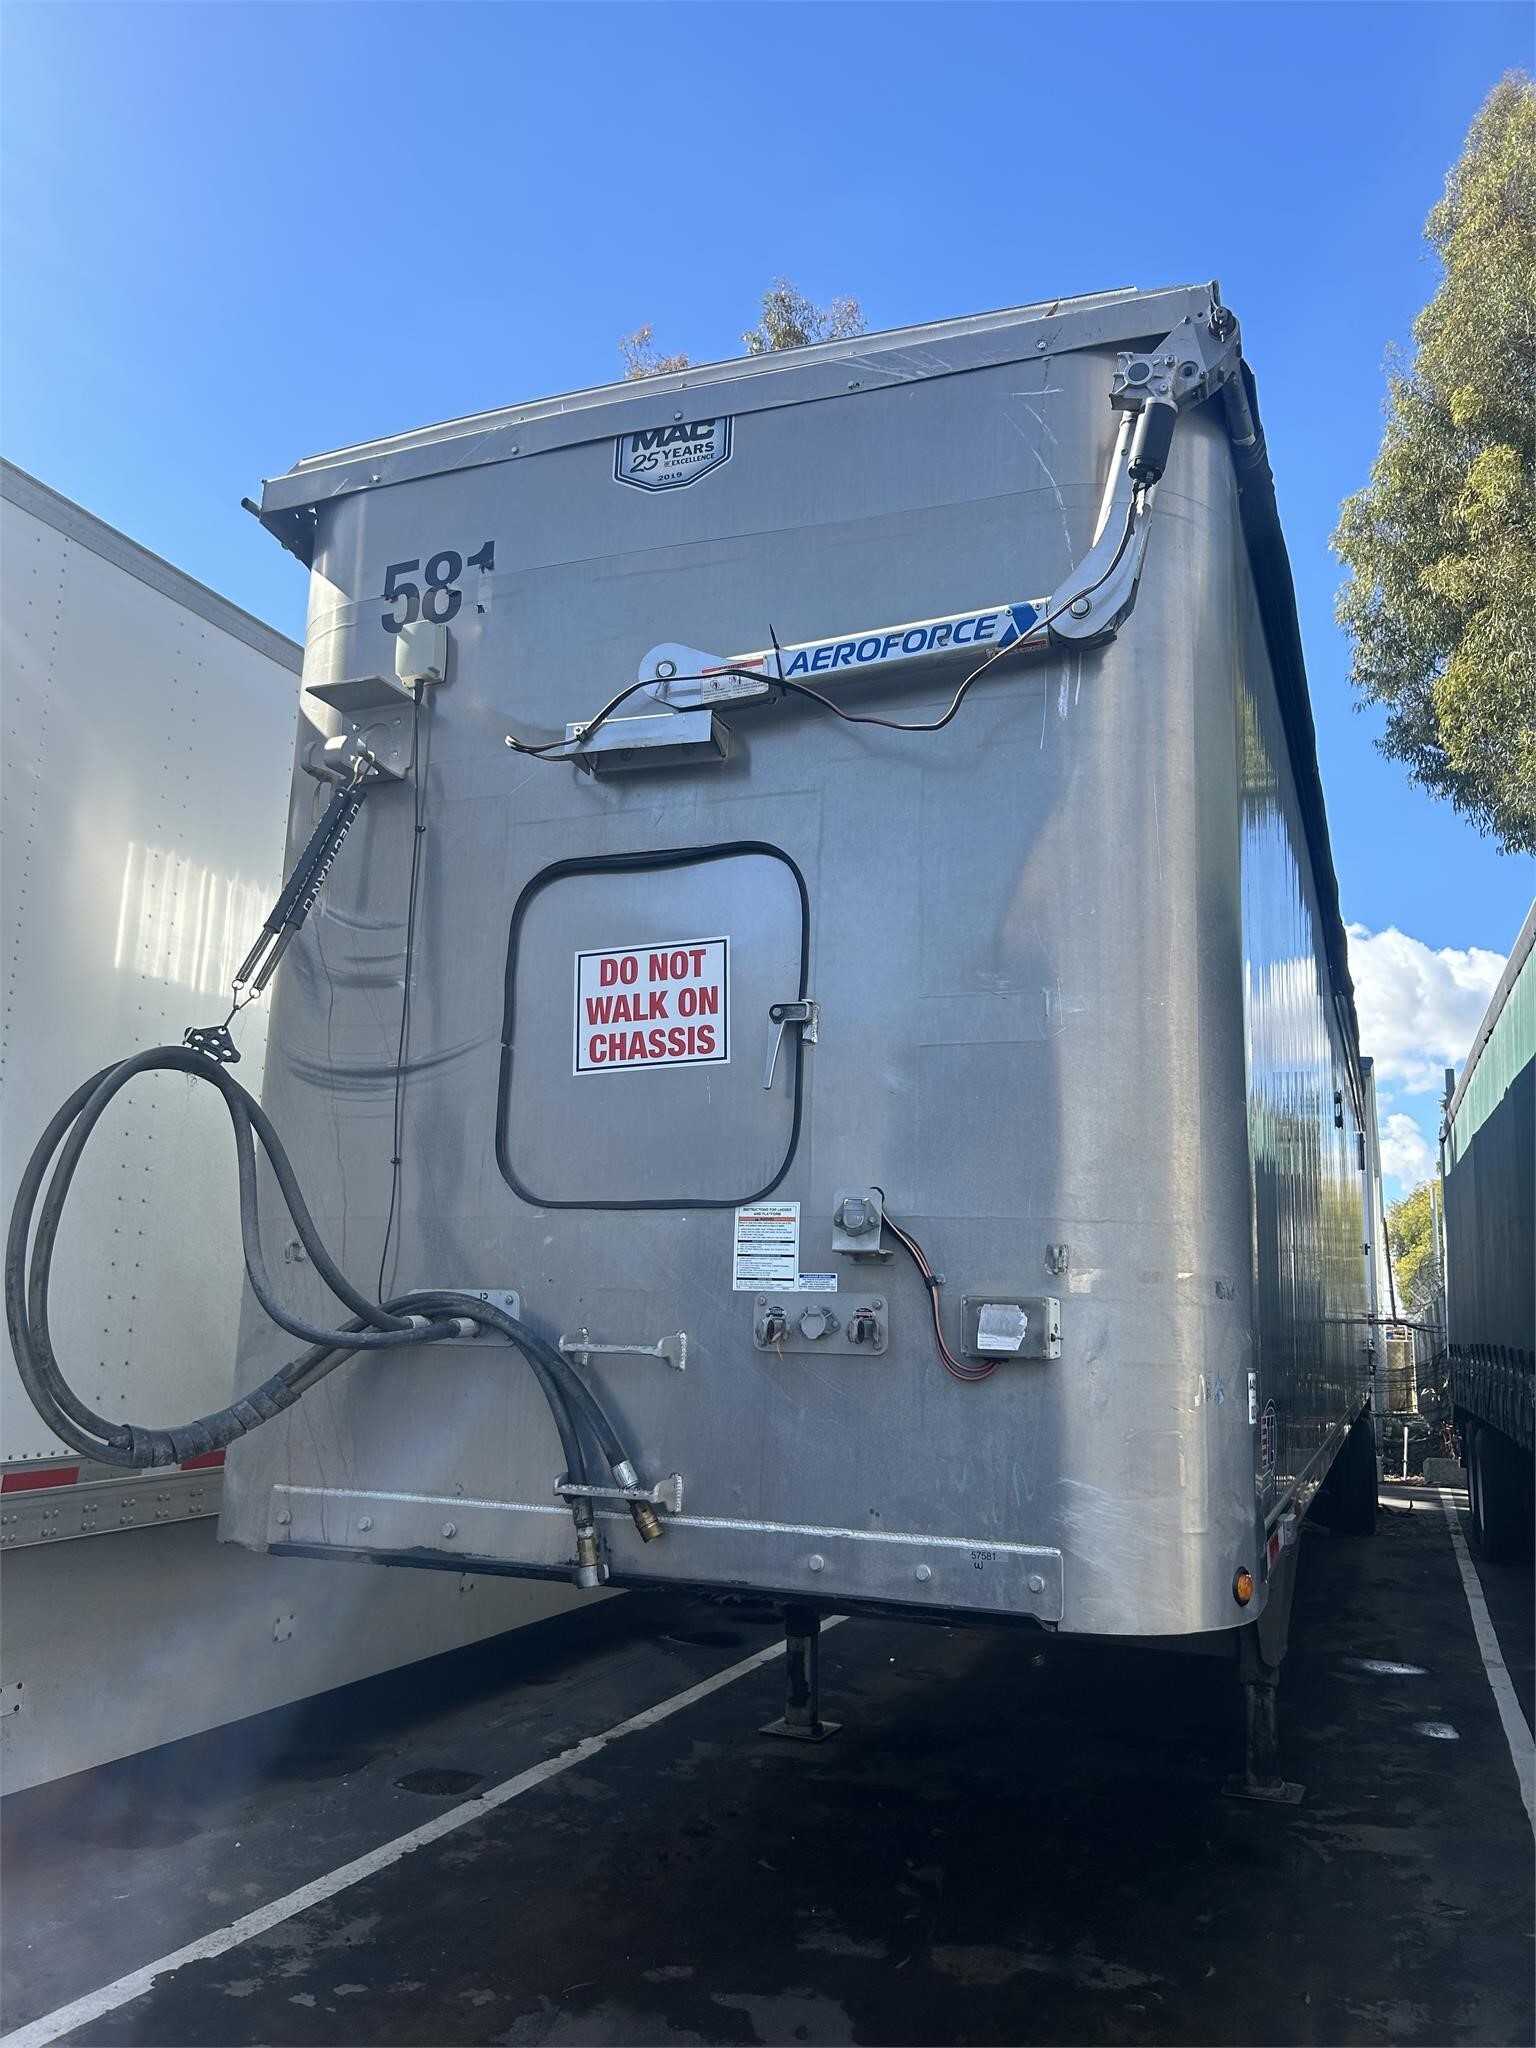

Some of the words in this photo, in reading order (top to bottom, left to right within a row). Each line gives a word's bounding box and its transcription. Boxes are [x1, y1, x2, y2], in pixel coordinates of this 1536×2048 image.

[632, 420, 715, 452] MAC
[630, 450, 660, 473] 25
[662, 441, 715, 460] YEARS
[672, 453, 715, 466] EXCELLENCE
[657, 472, 682, 481] 2019
[785, 614, 998, 676] AEROFORCE
[600, 956, 638, 986] DO
[649, 949, 706, 982] NOT
[586, 990, 668, 1025] WALK
[678, 986, 718, 1018] ON
[589, 1024, 715, 1063] CHASSIS
[971, 1551, 997, 1561] 57581
